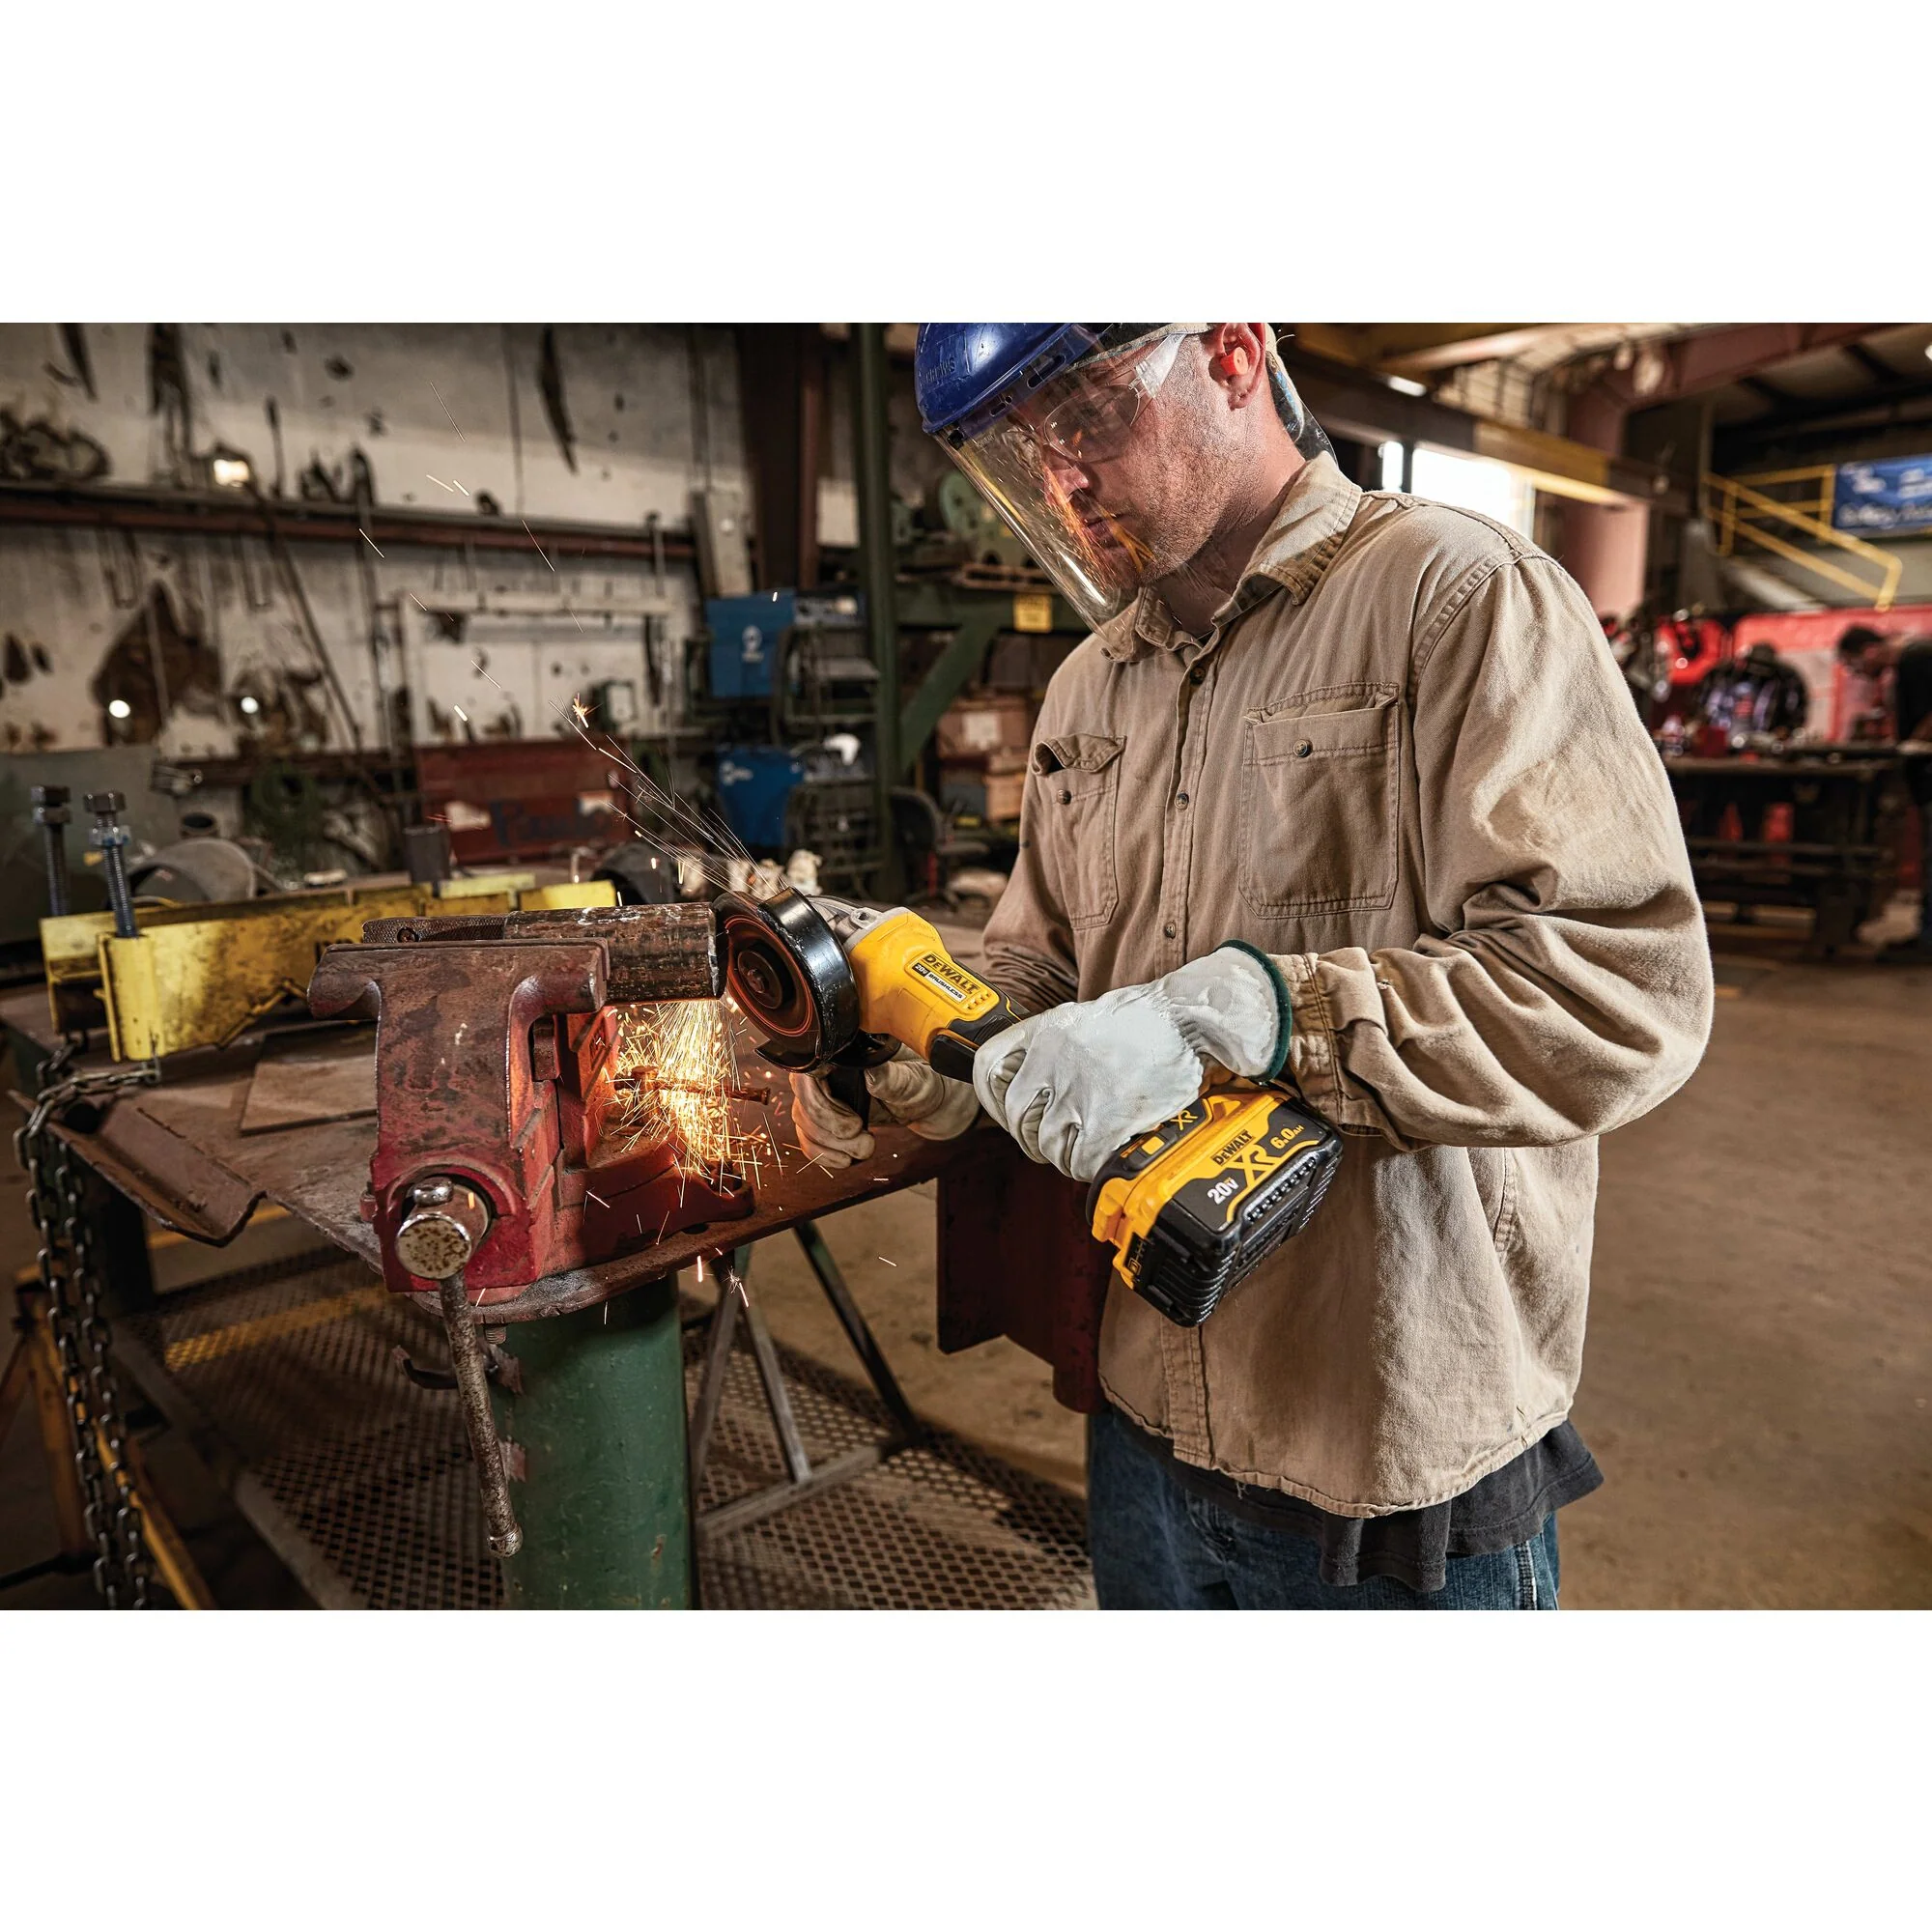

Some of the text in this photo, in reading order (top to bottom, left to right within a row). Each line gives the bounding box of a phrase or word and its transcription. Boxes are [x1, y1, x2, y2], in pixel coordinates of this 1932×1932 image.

[914, 963, 963, 999] 20V BRUSHLESS
[1170, 1110, 1198, 1130] XR
[1224, 1144, 1281, 1188] XR
[1208, 1178, 1239, 1205] 20V
